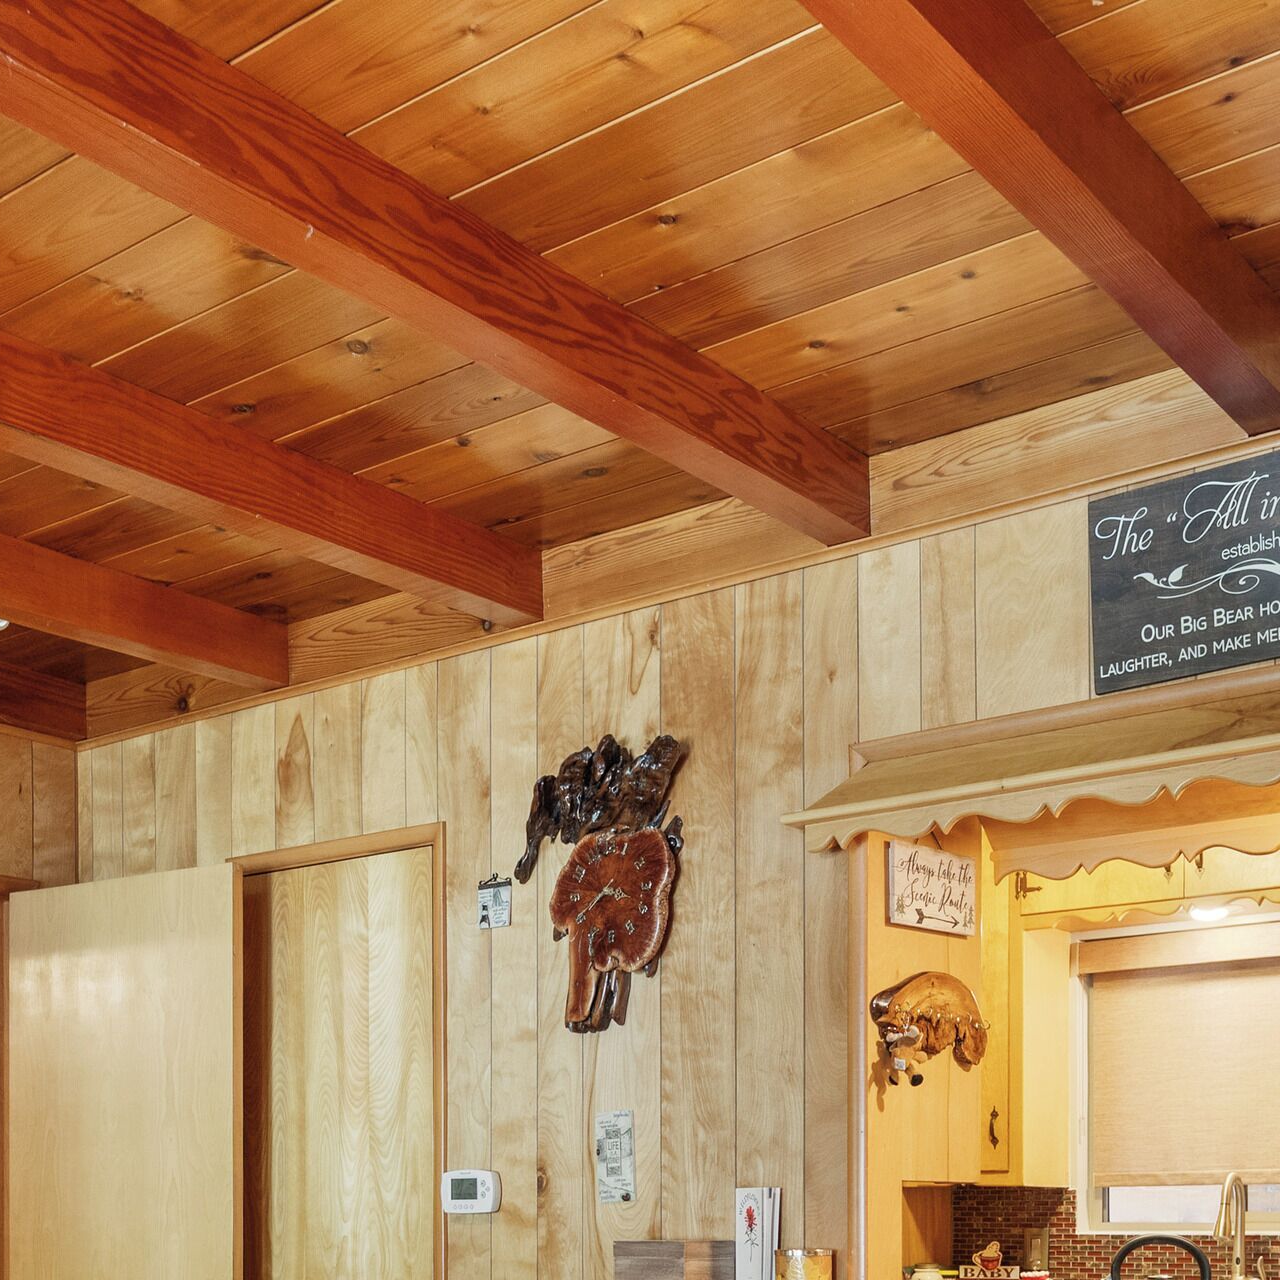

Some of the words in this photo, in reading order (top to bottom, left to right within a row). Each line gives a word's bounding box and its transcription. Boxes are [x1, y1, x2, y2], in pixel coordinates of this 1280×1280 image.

[1095, 506, 1154, 560] The
[893, 850, 935, 888] Always
[937, 859, 956, 884] take
[958, 863, 973, 888] the
[903, 877, 937, 908] Scenic
[938, 882, 968, 917] Route
[963, 1267, 1014, 1278] BABY
